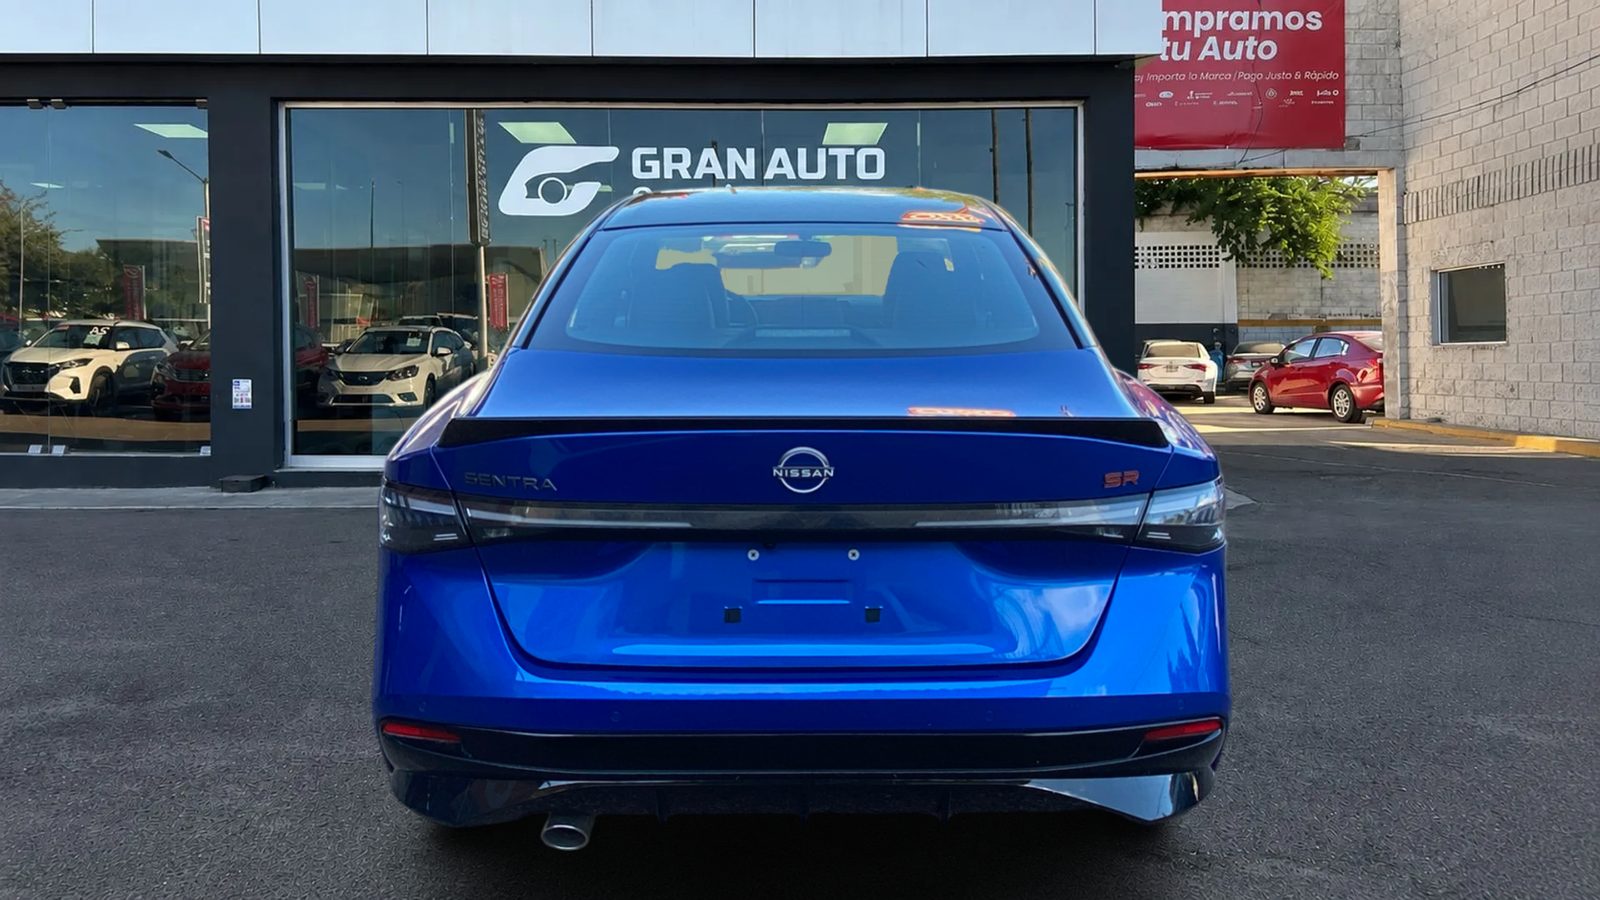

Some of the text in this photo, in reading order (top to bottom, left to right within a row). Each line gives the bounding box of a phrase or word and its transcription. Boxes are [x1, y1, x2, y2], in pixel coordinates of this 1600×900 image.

[1162, 11, 1323, 38] mpramos
[1160, 35, 1279, 61] tu Auto
[1146, 73, 1186, 83] Importa
[1200, 72, 1231, 80] Marca
[1304, 71, 1339, 81] Rápido
[632, 147, 886, 179] GRAN AUTO
[464, 471, 557, 491] SENTRA
[772, 468, 834, 478] NISSAN
[1104, 470, 1140, 488] SR
